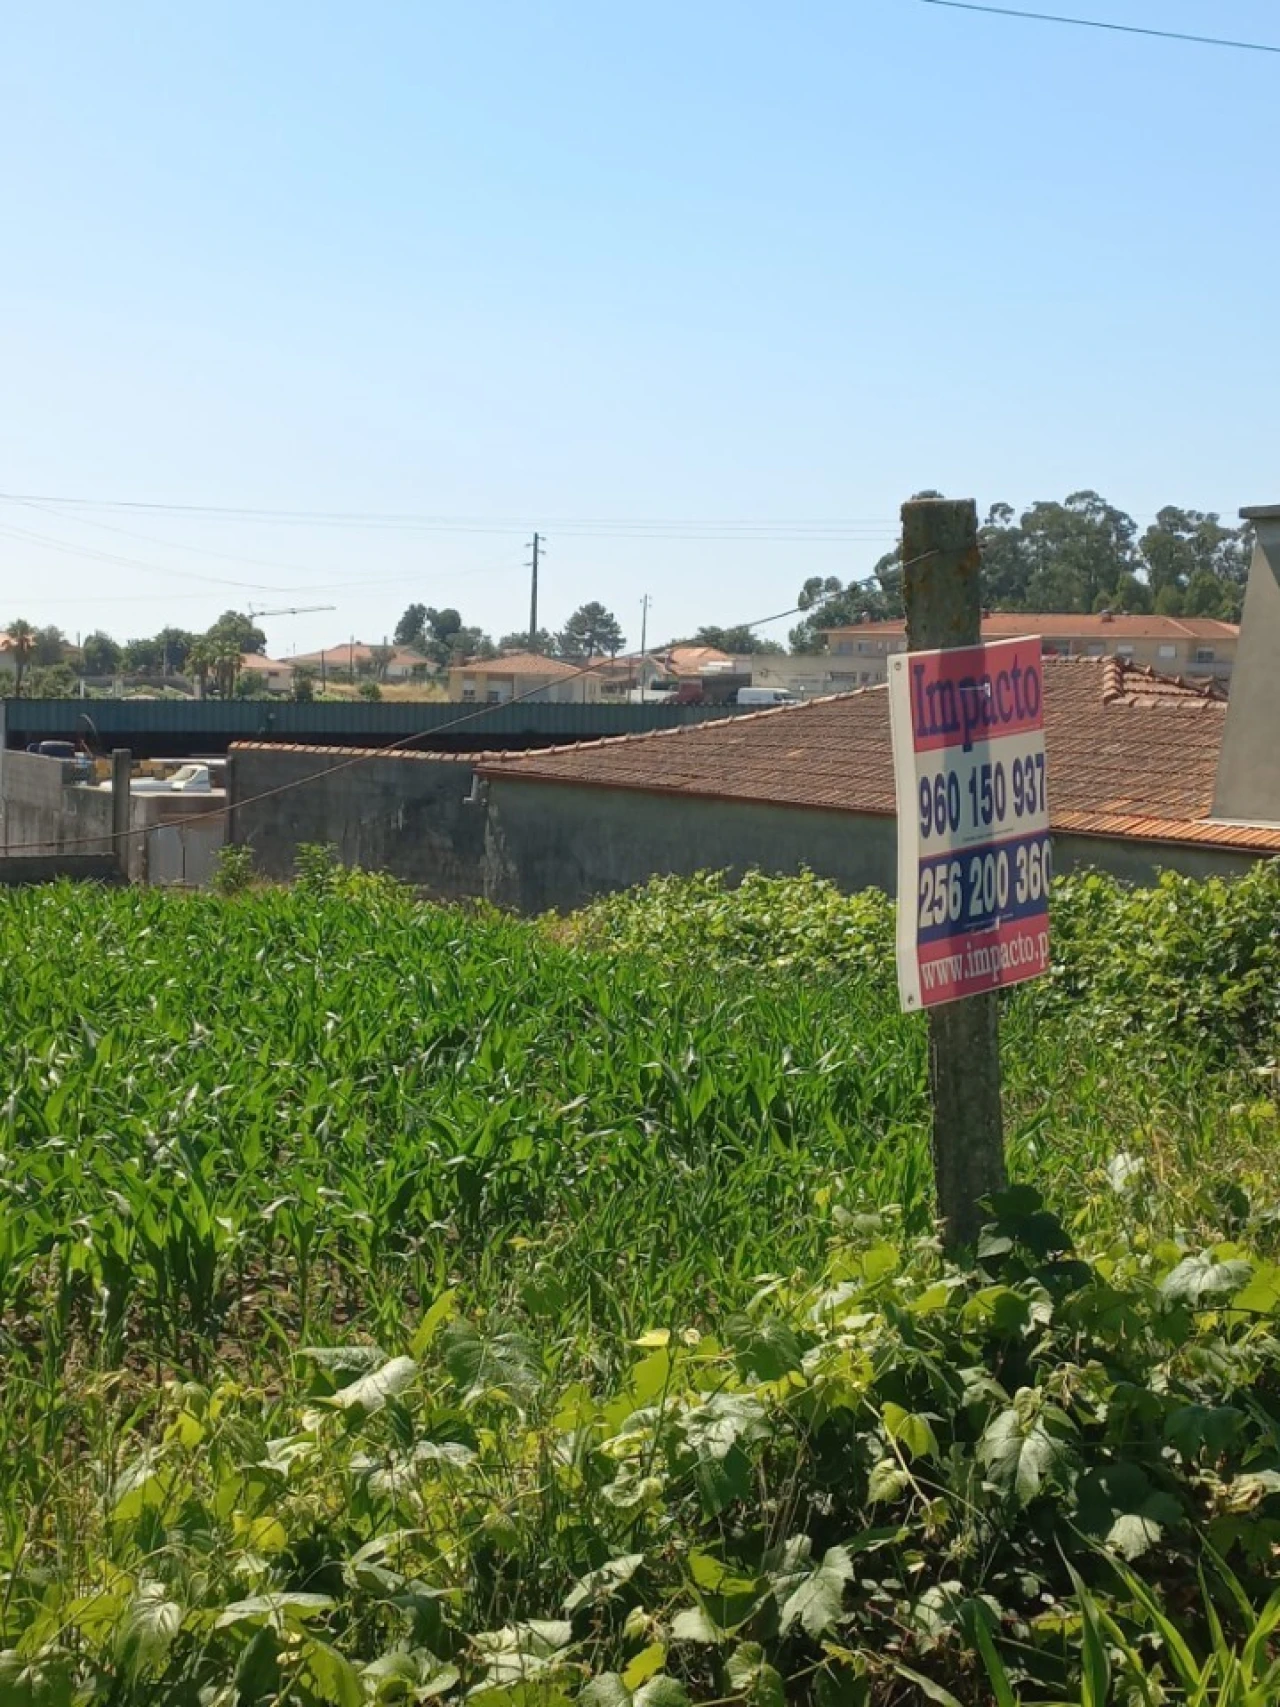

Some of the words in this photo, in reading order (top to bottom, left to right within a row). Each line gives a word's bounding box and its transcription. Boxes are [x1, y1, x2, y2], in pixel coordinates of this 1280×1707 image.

[913, 653, 1040, 752] Impacto
[919, 769, 960, 839] 960
[968, 761, 1006, 828] 150
[1012, 752, 1046, 817] 937
[919, 860, 962, 928] 256
[969, 850, 1009, 917] 200
[1016, 838, 1052, 904] 360
